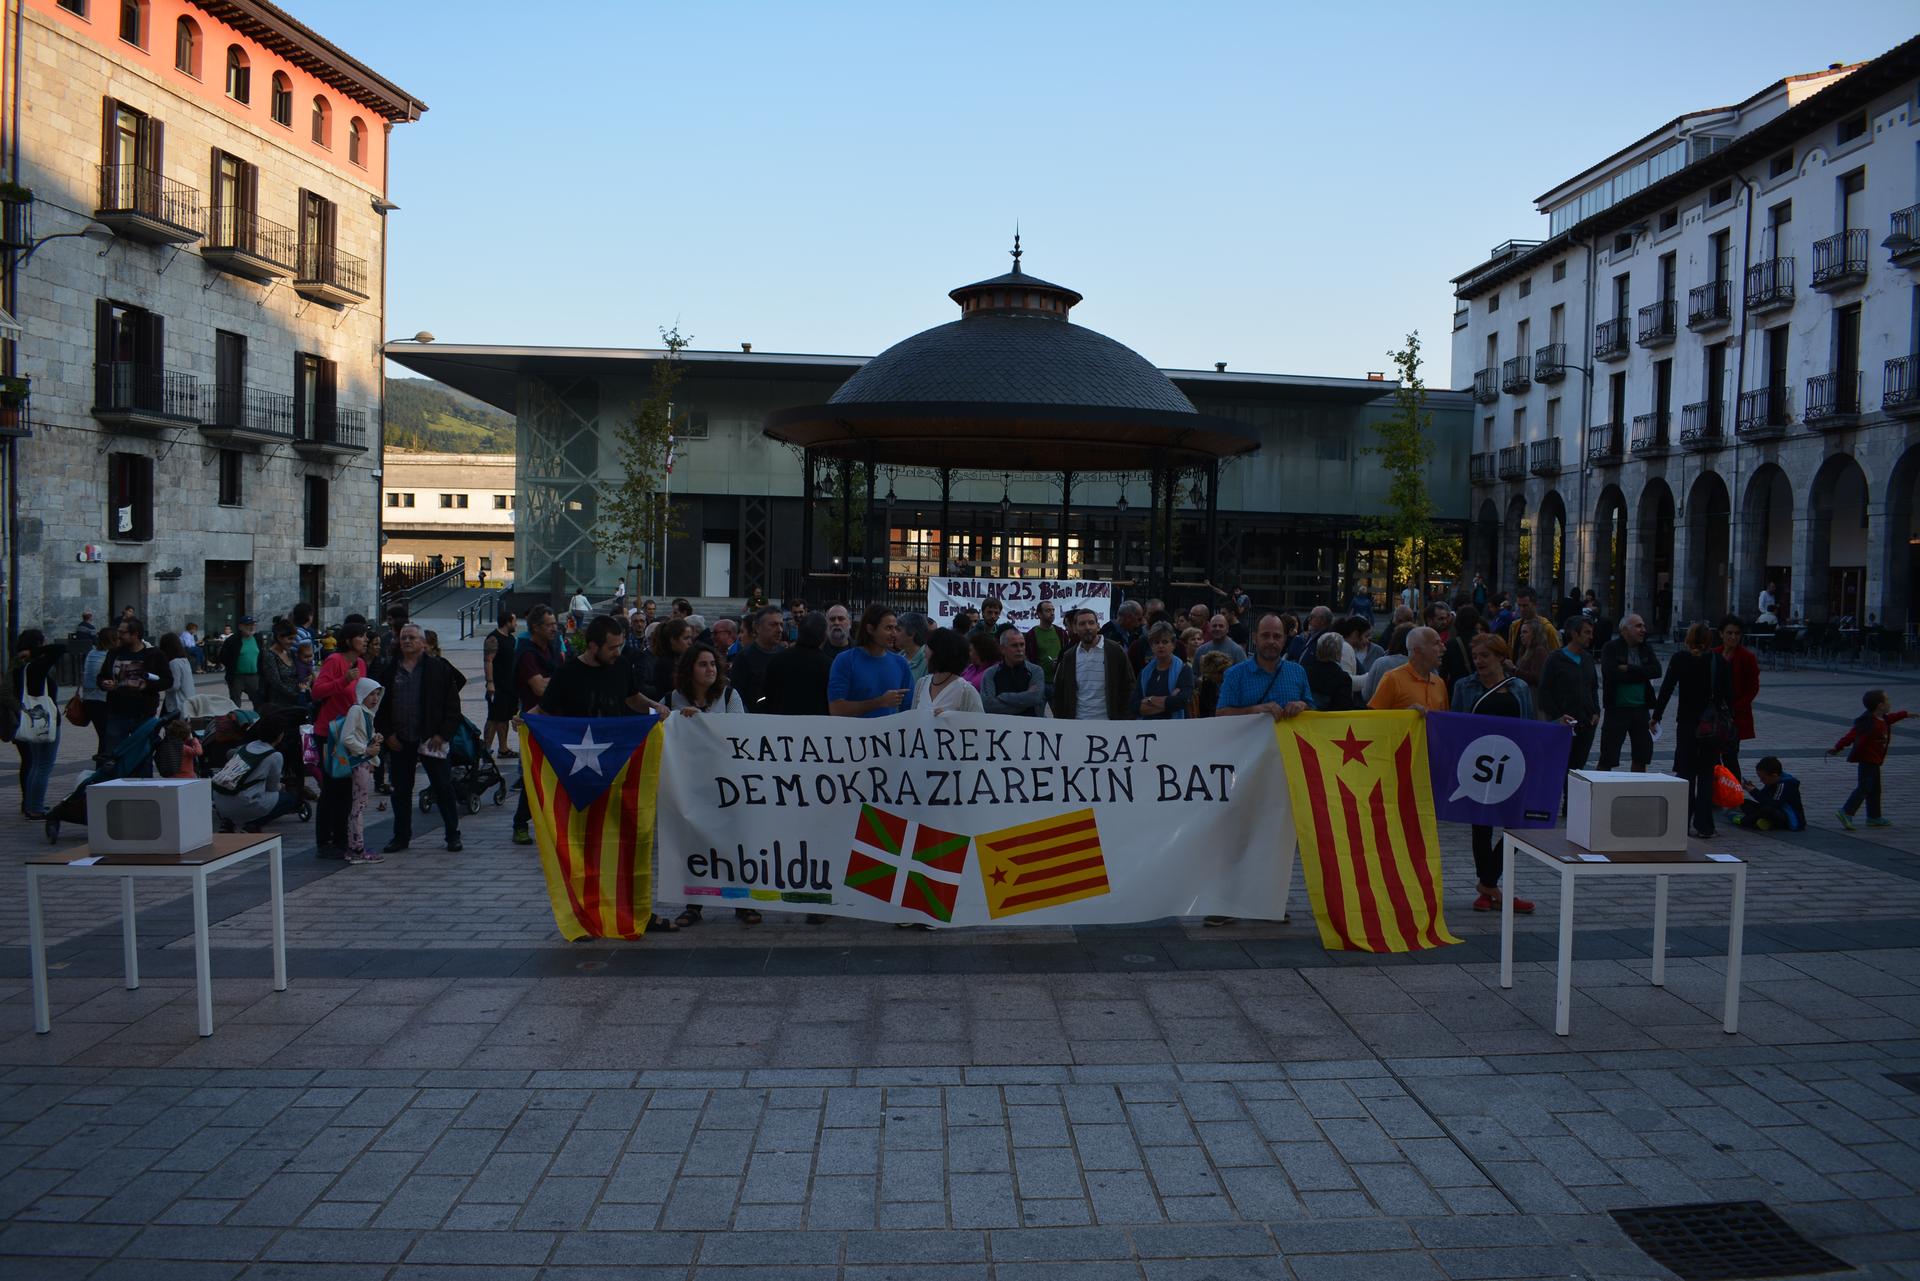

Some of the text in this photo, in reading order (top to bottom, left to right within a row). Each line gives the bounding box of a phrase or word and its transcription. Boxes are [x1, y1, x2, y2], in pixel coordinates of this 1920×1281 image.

[726, 727, 1158, 764] KATALUNIAREKIN BAT
[714, 763, 1235, 809] DEMOKRAZIAREKIN BAT
[1472, 754, 1511, 785] Sí
[686, 839, 833, 890] ehbildu
